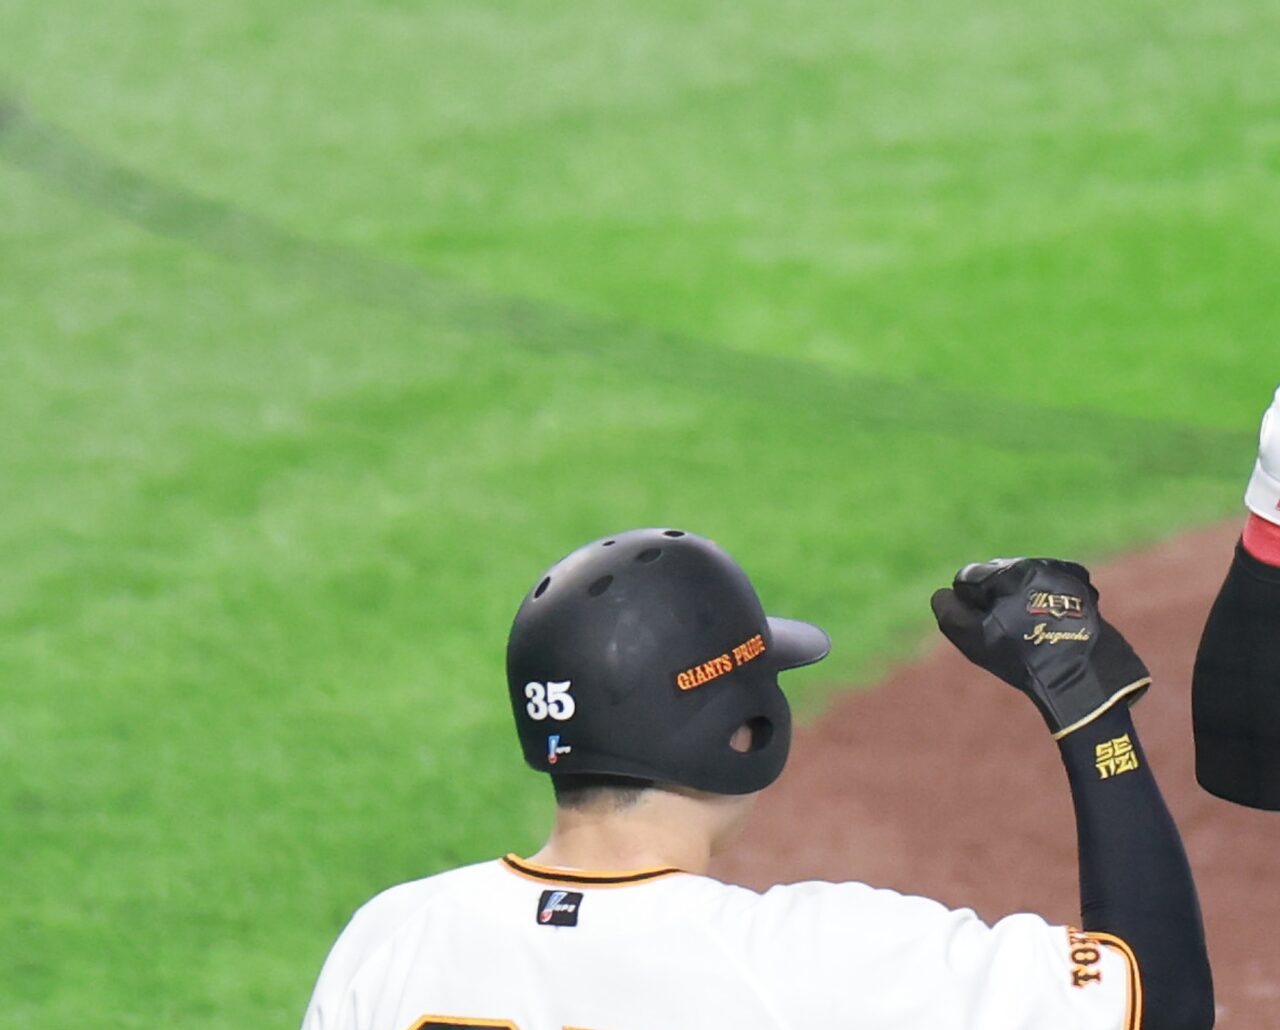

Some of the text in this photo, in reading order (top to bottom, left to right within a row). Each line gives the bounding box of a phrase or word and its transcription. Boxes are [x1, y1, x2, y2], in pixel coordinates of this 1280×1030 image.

[677, 633, 766, 691] GIANTS PRIDE
[524, 680, 576, 721] 35
